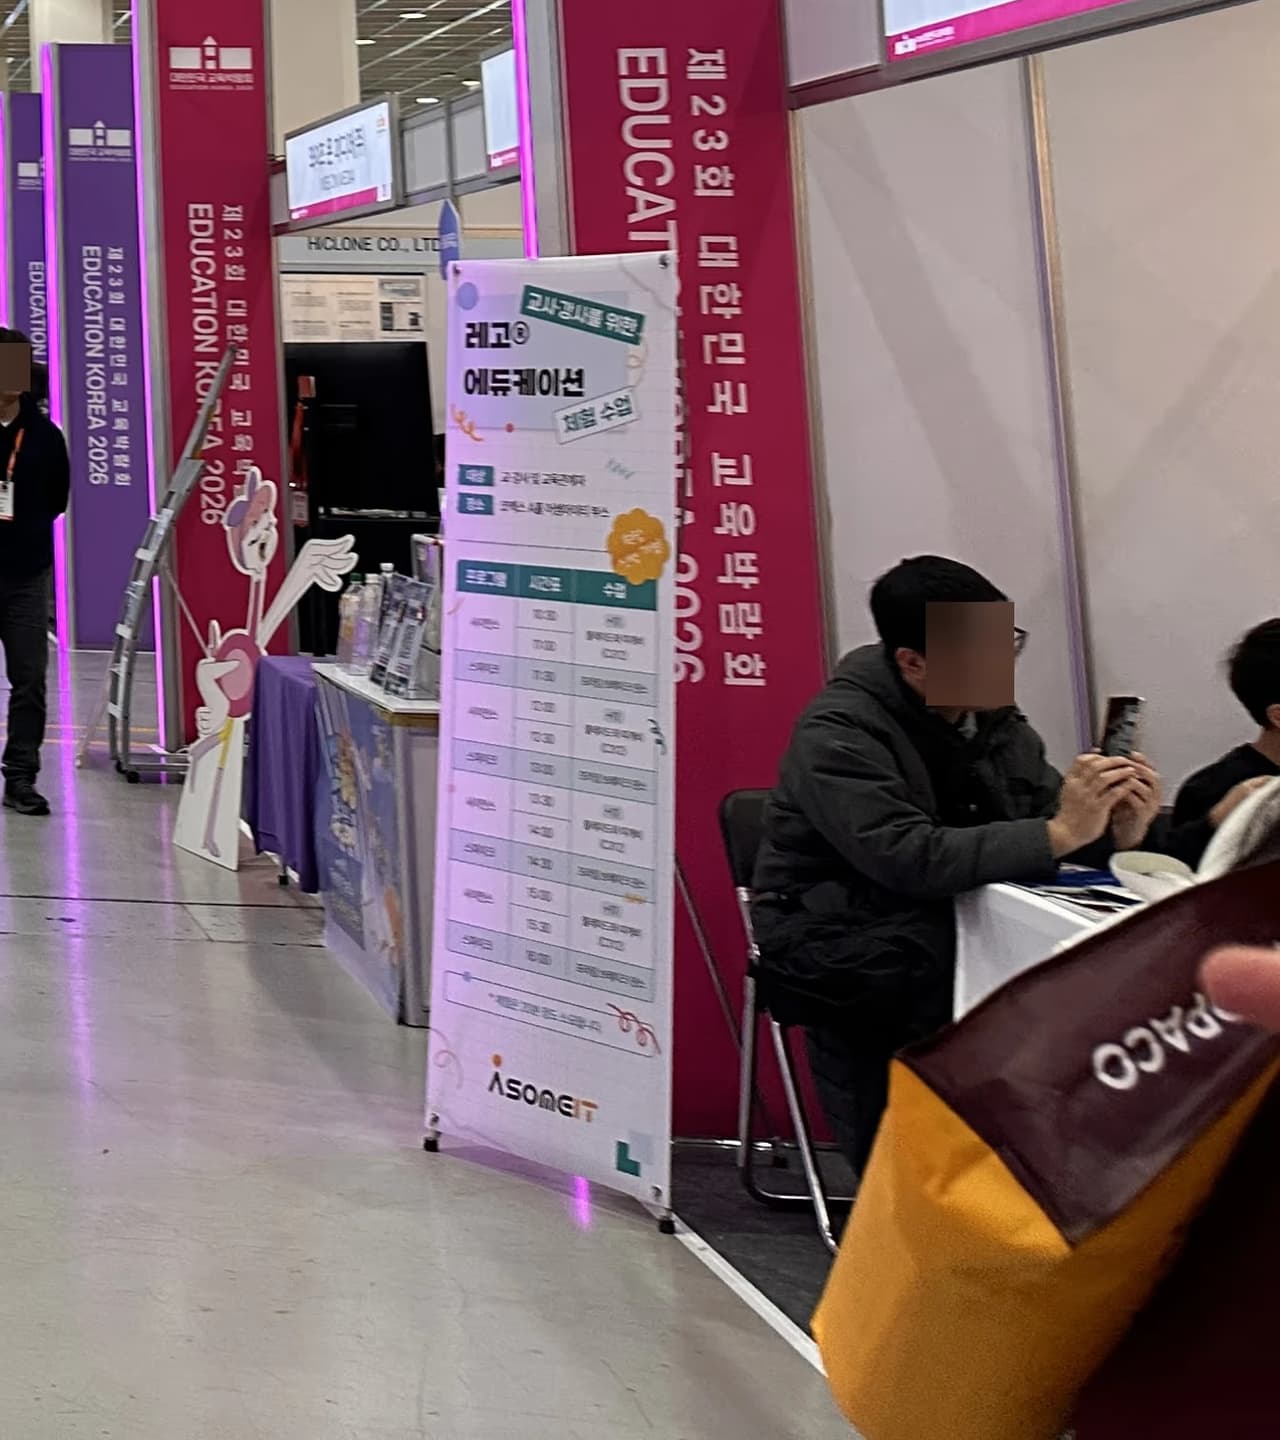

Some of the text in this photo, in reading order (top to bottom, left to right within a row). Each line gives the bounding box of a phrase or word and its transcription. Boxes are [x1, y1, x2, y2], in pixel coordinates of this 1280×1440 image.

[188, 204, 220, 352] EDUCATION
[82, 245, 109, 486] EDUCATION KOREA 2026
[464, 368, 585, 397] 에듀케이션
[600, 394, 633, 420] 수업
[687, 48, 766, 686] 제23회 대한민국 교육박람회
[201, 460, 227, 525] 2026
[1093, 992, 1244, 1090] PACO
[488, 1054, 598, 1123] ASOMEIT
